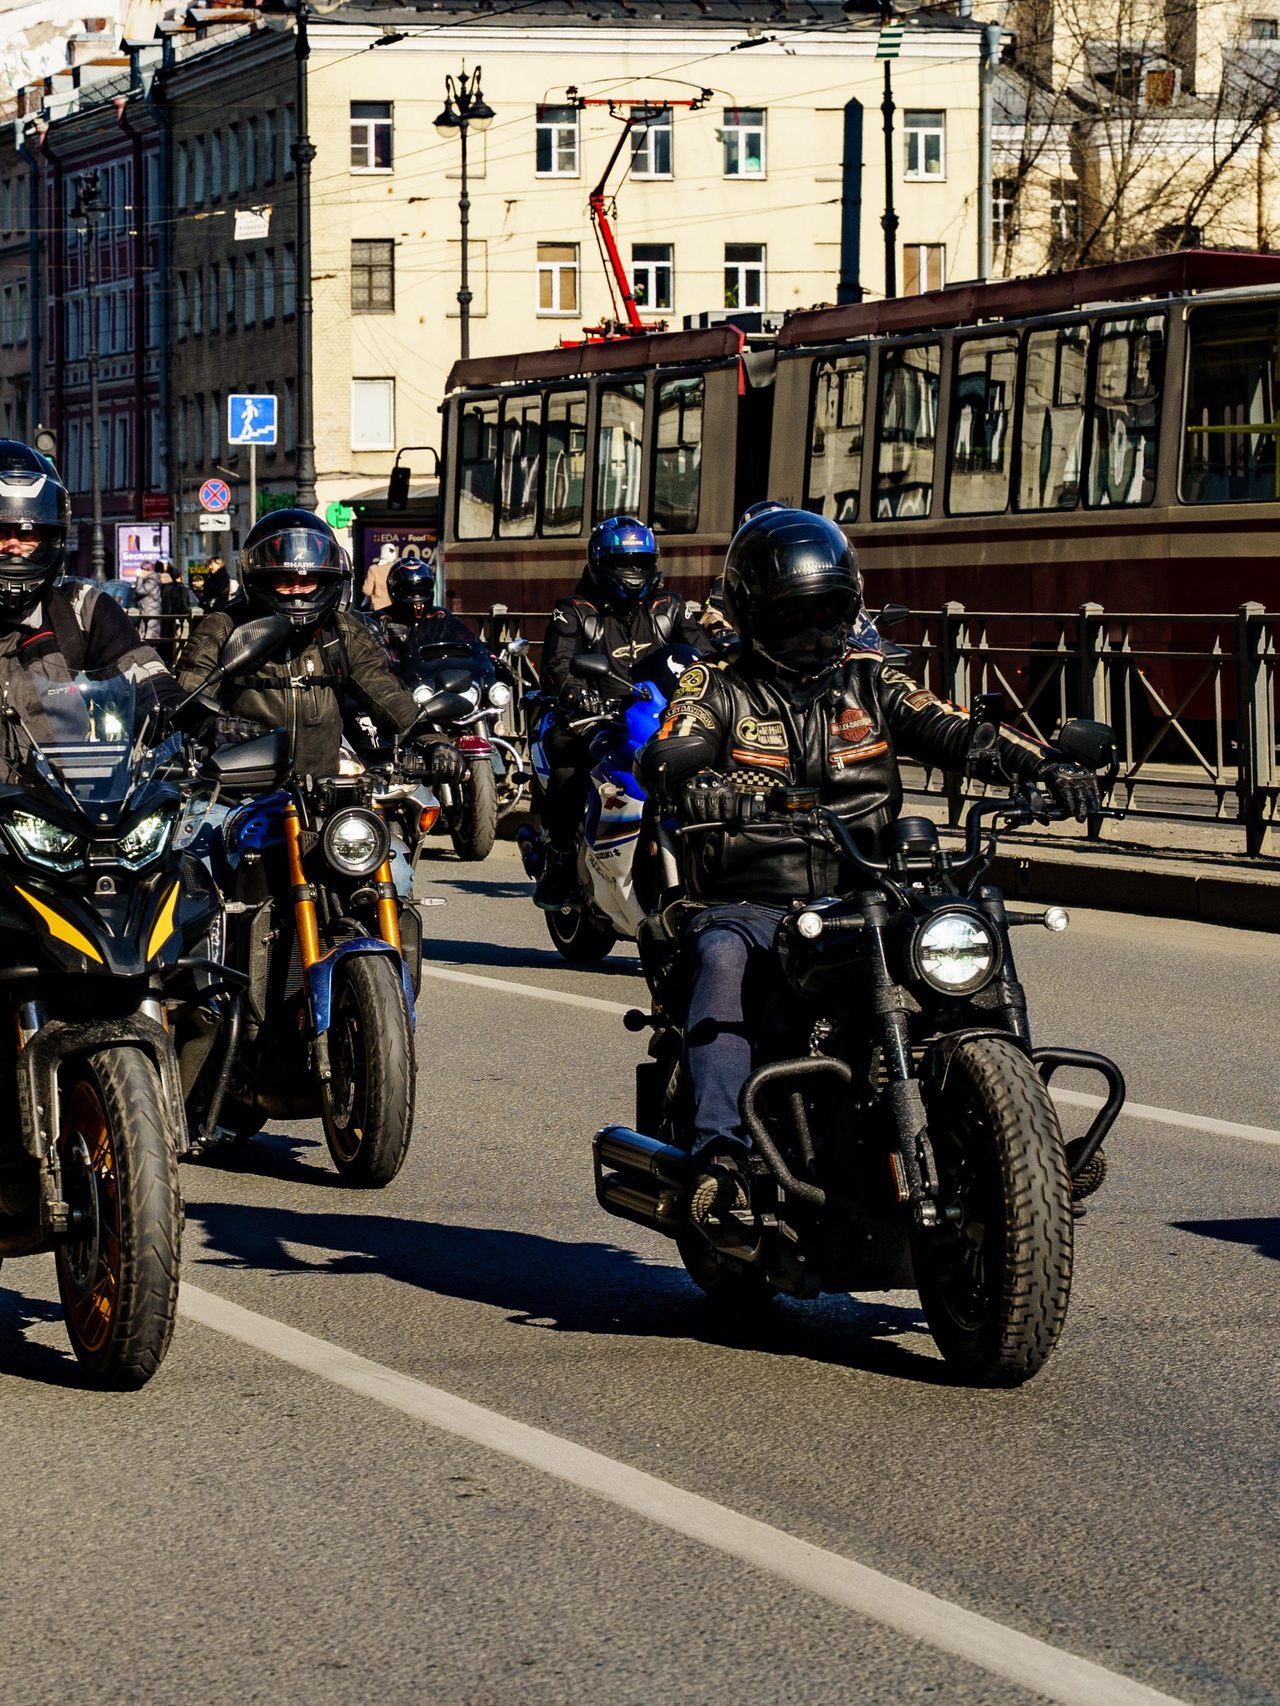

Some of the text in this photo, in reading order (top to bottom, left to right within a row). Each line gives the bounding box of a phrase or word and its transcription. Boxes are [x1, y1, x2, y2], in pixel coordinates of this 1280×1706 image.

[0, 509, 39, 517] SHARK
[381, 534, 399, 542] EDA
[682, 673, 700, 684] 26
[681, 705, 713, 728] DAVIDSON
